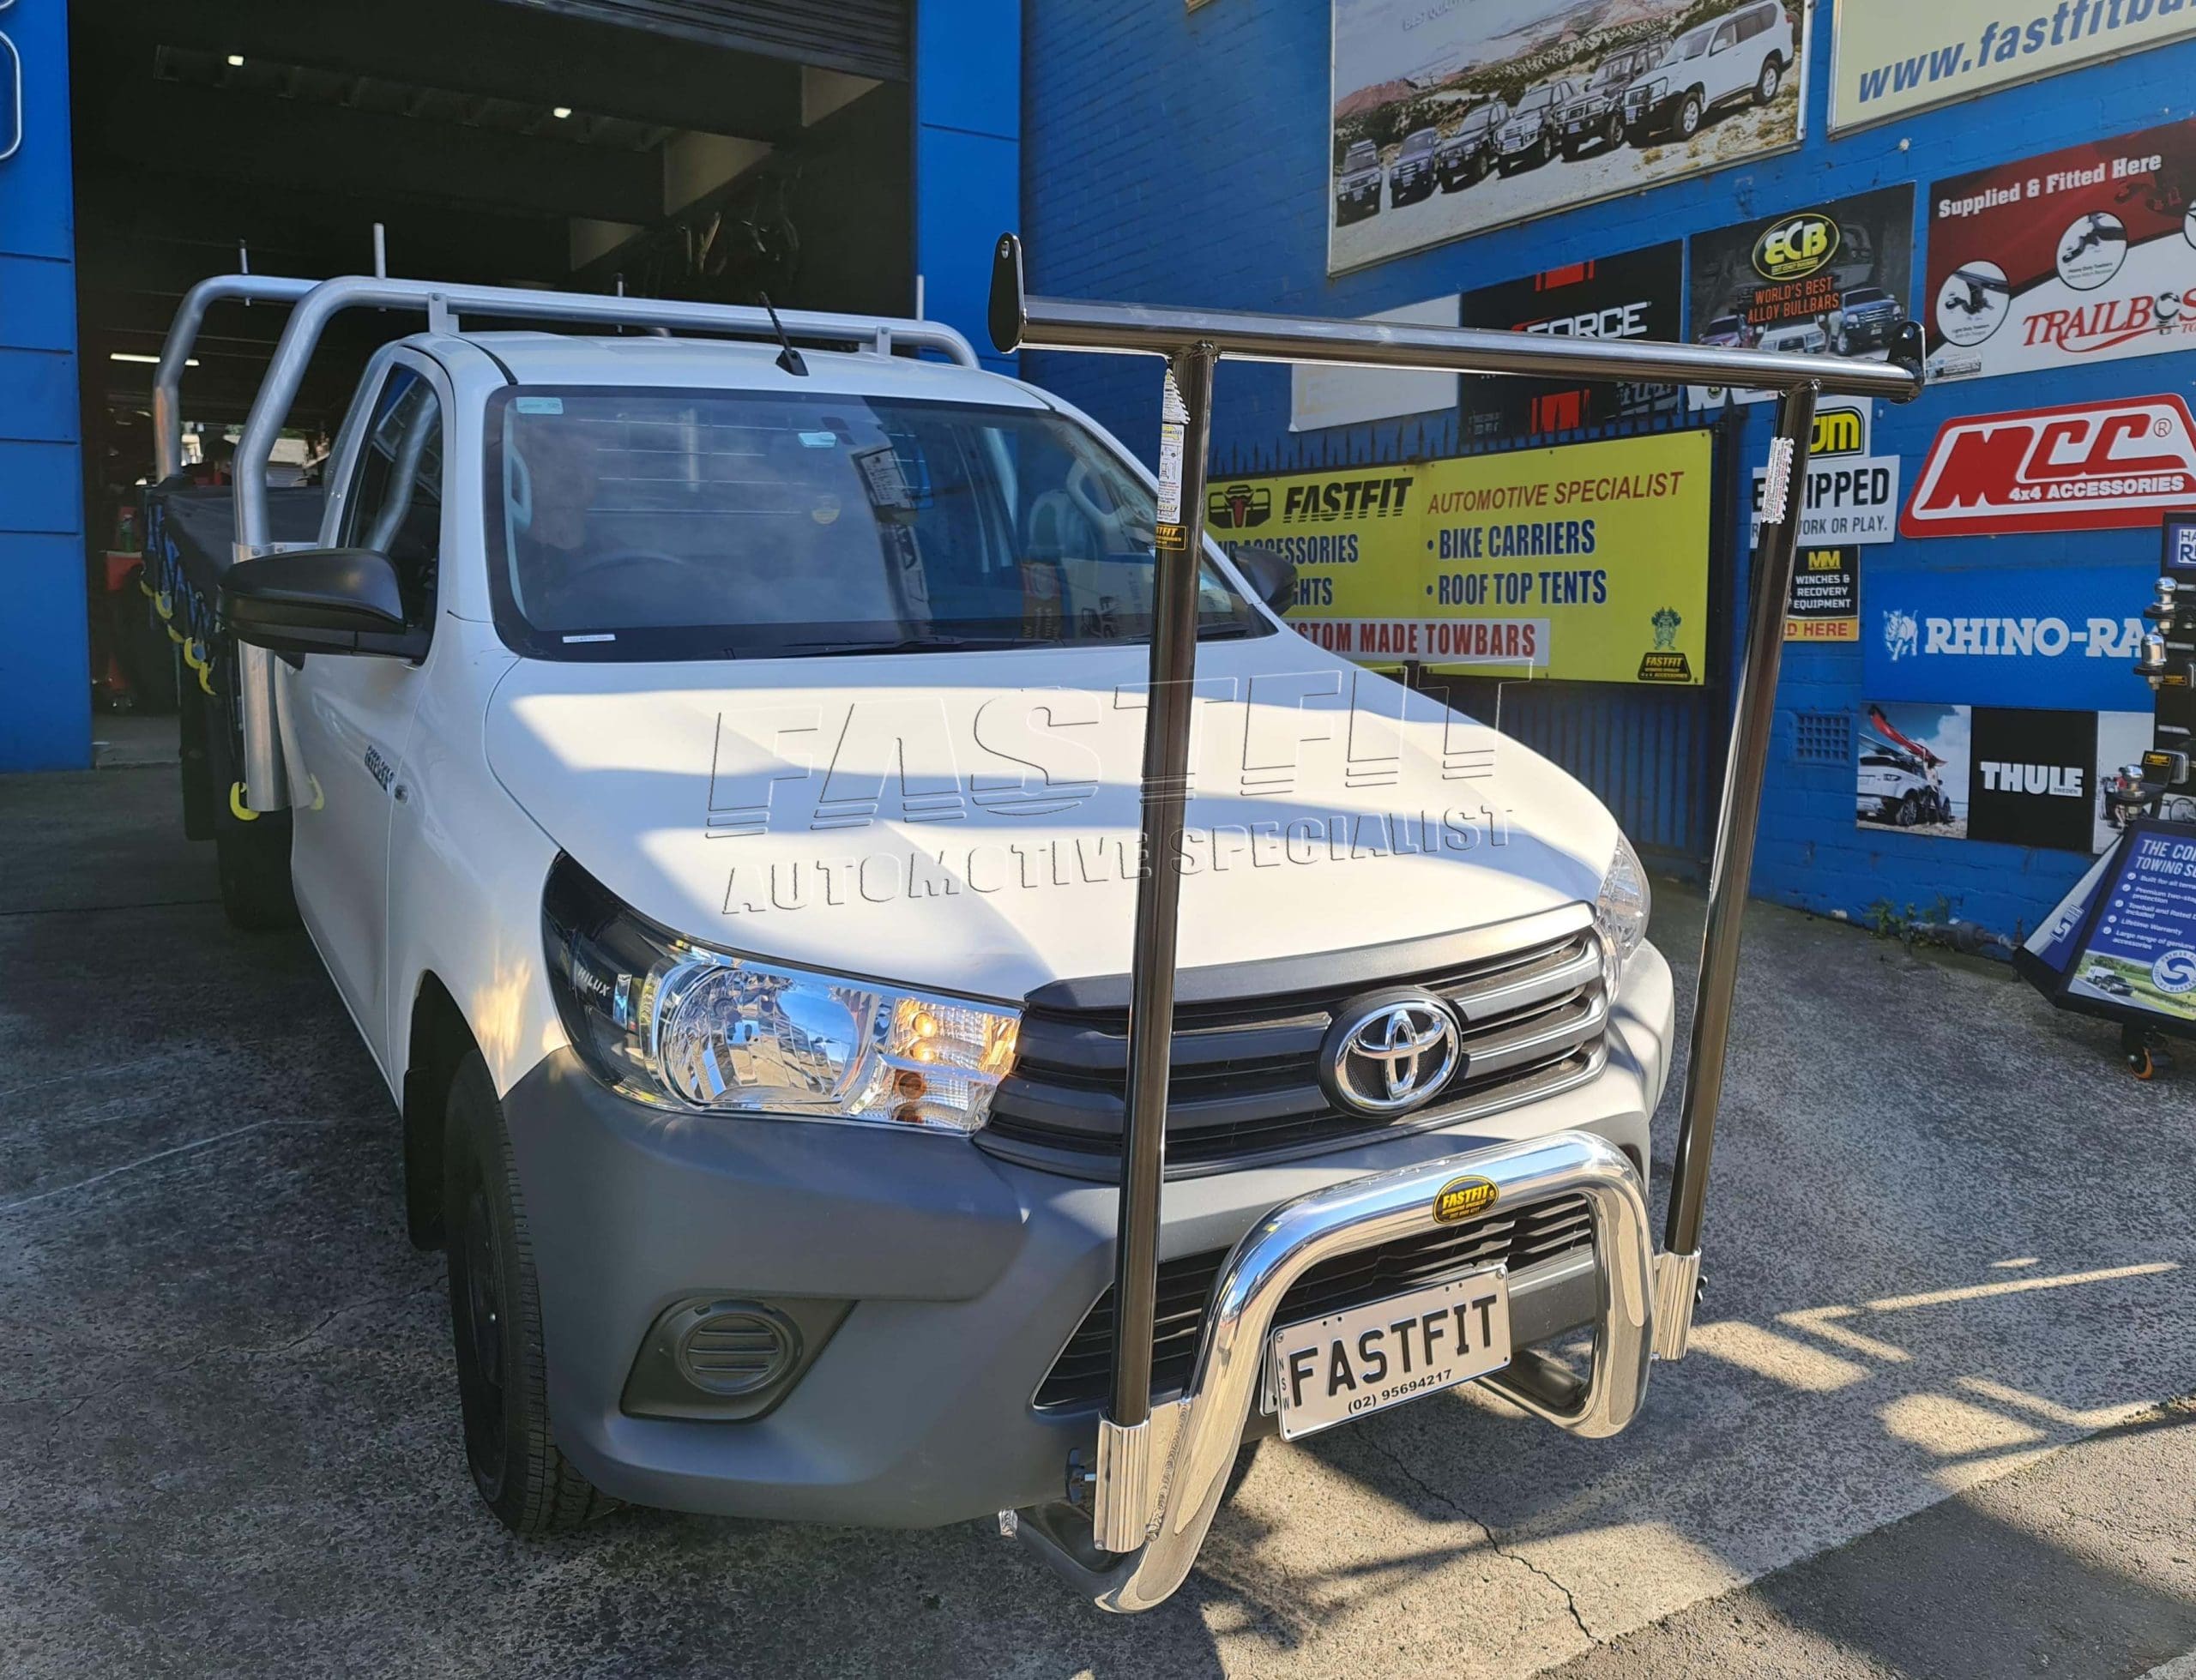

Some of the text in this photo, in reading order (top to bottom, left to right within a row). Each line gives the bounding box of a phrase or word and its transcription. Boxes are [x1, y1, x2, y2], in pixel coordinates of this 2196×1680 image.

[1939, 154, 2162, 217] Supplied & Fitted Here
[1765, 220, 1828, 264] ECB
[1755, 275, 1833, 305] WORLD'S BEST
[1747, 292, 1839, 324] ALLOY BULLBARS
[1920, 413, 2188, 511] MCC
[1282, 476, 1415, 524] FASTFIT
[1427, 471, 1684, 515] AUTOMOTIVE SPECIALIST
[1752, 468, 1889, 513] EIPPED
[2009, 476, 2184, 501] 4x4 ACCESSORIES
[1439, 520, 1596, 560] BIKE CARRIERS
[1799, 515, 1887, 536] ORK OR PLAY.
[1438, 569, 1607, 605] ROOF TOP TENTS
[1795, 574, 1850, 584] WINCHES &
[1797, 587, 1849, 597] RECOVERY
[1794, 599, 1851, 610] EQUIPMENT
[1360, 623, 1418, 654] MADE
[1425, 623, 1535, 657] TOWBARS
[1803, 623, 1848, 636] HERE
[1925, 617, 2155, 659] RHINO-RA
[1646, 657, 1682, 666] FASTFIT
[1980, 761, 2084, 798] THULE
[2141, 840, 2171, 857] THE
[2135, 856, 2183, 876] TOWING
[577, 966, 611, 997] HILUX
[1442, 1184, 1490, 1209] FASTFIT
[1288, 1295, 1498, 1408] FASTFIT
[1347, 1369, 1452, 1414] (02) 95694217
